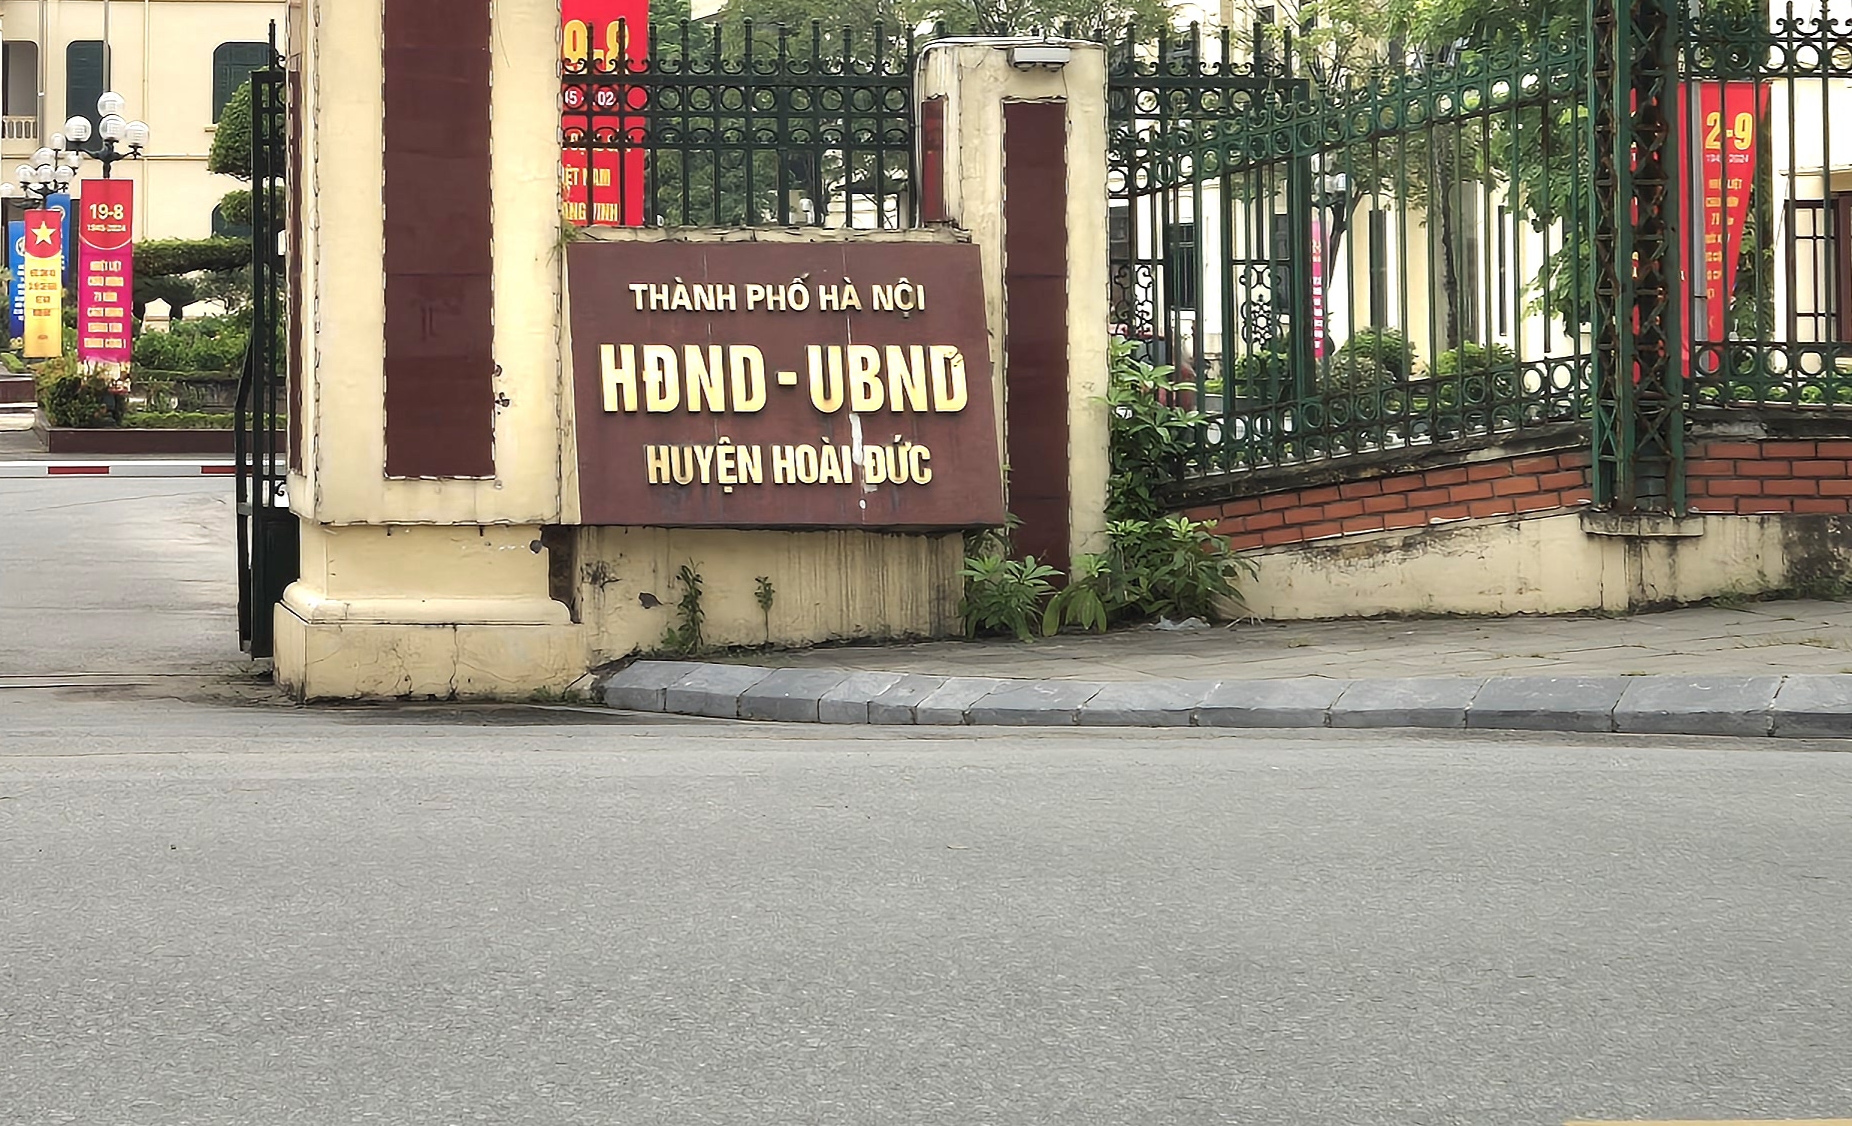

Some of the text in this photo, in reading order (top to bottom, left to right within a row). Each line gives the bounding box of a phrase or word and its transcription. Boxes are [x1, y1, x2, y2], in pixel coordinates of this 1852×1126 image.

[1705, 111, 1754, 151] 2-9
[89, 203, 125, 220] 19-8
[628, 272, 926, 318] THÀNH PHỐ HÀ NỘI
[645, 434, 934, 493] HUYỆN HOÀI ĐỨC
